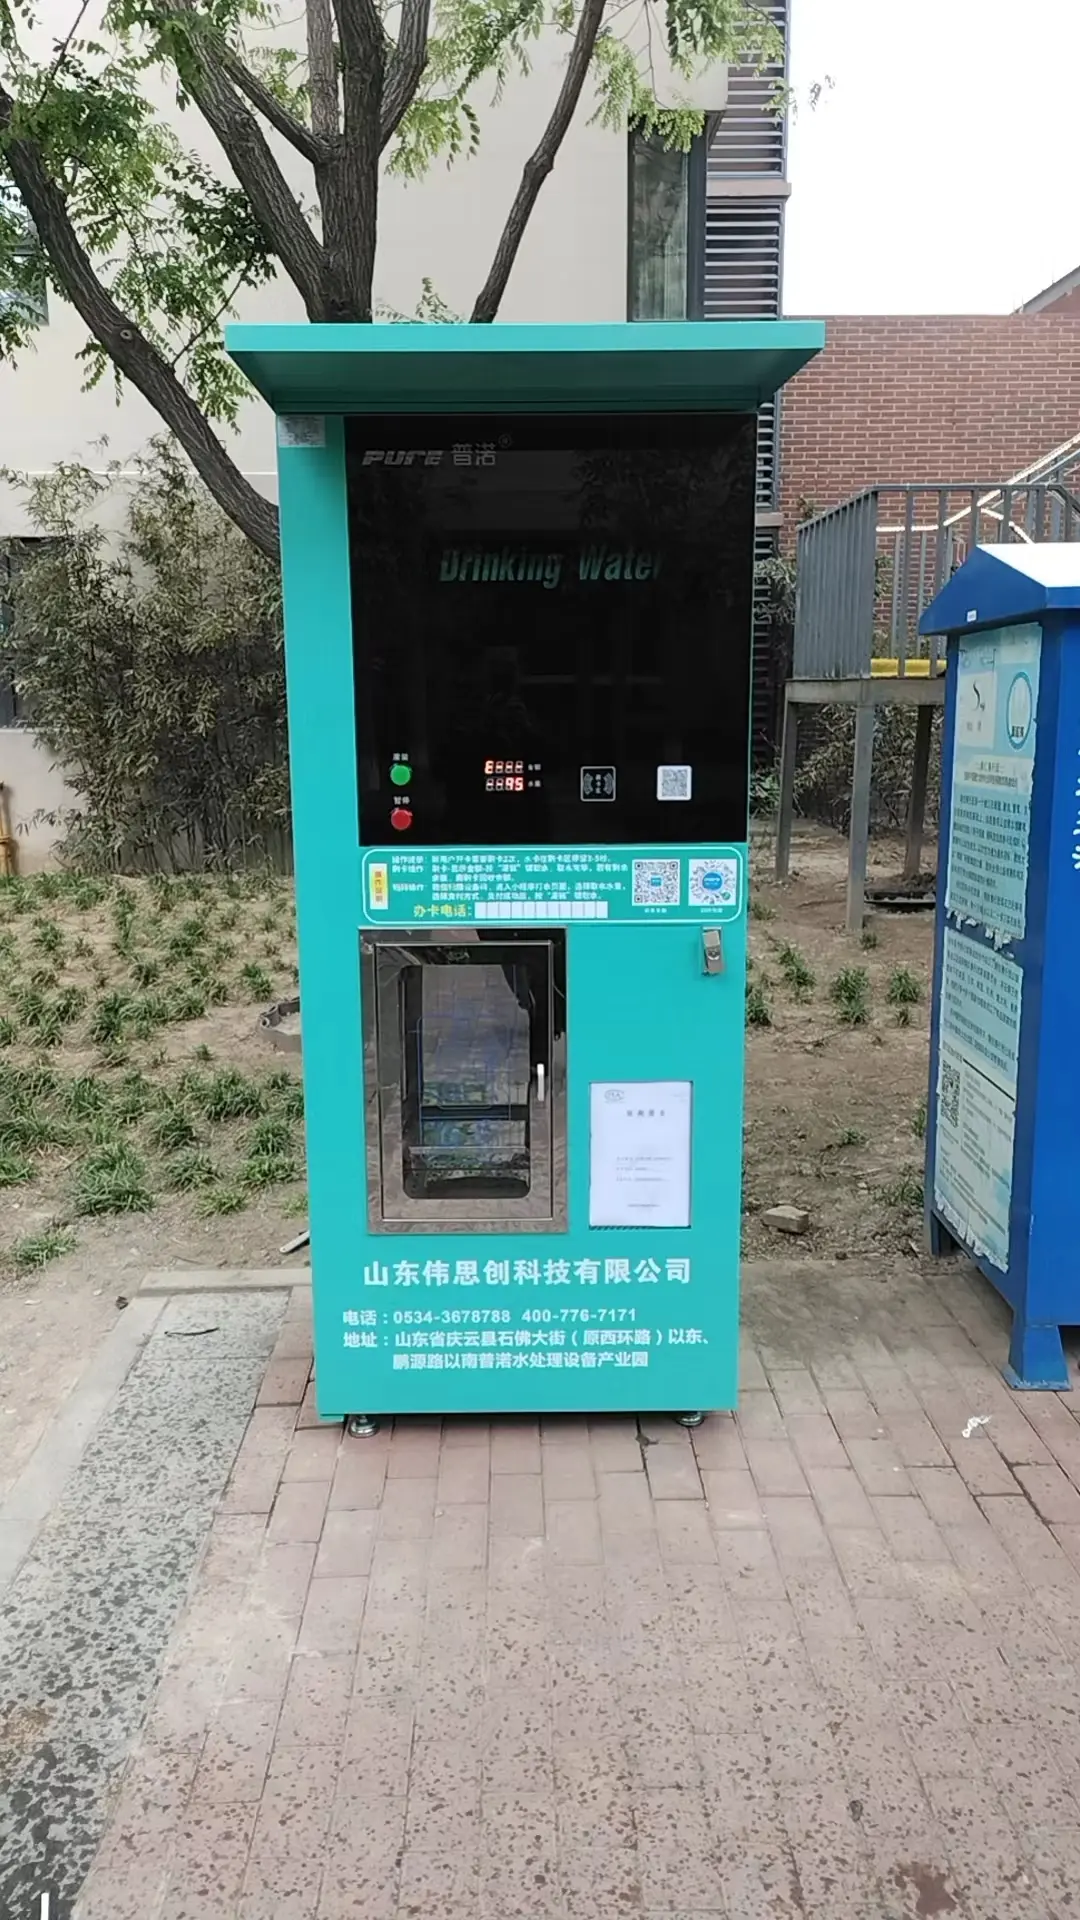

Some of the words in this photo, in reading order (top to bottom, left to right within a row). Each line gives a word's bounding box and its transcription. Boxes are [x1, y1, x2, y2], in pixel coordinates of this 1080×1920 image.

[439, 546, 564, 589] Drinking
[363, 1257, 692, 1287] 山东伟思创科技有限公司
[521, 1307, 637, 1323] 400-776-7171
